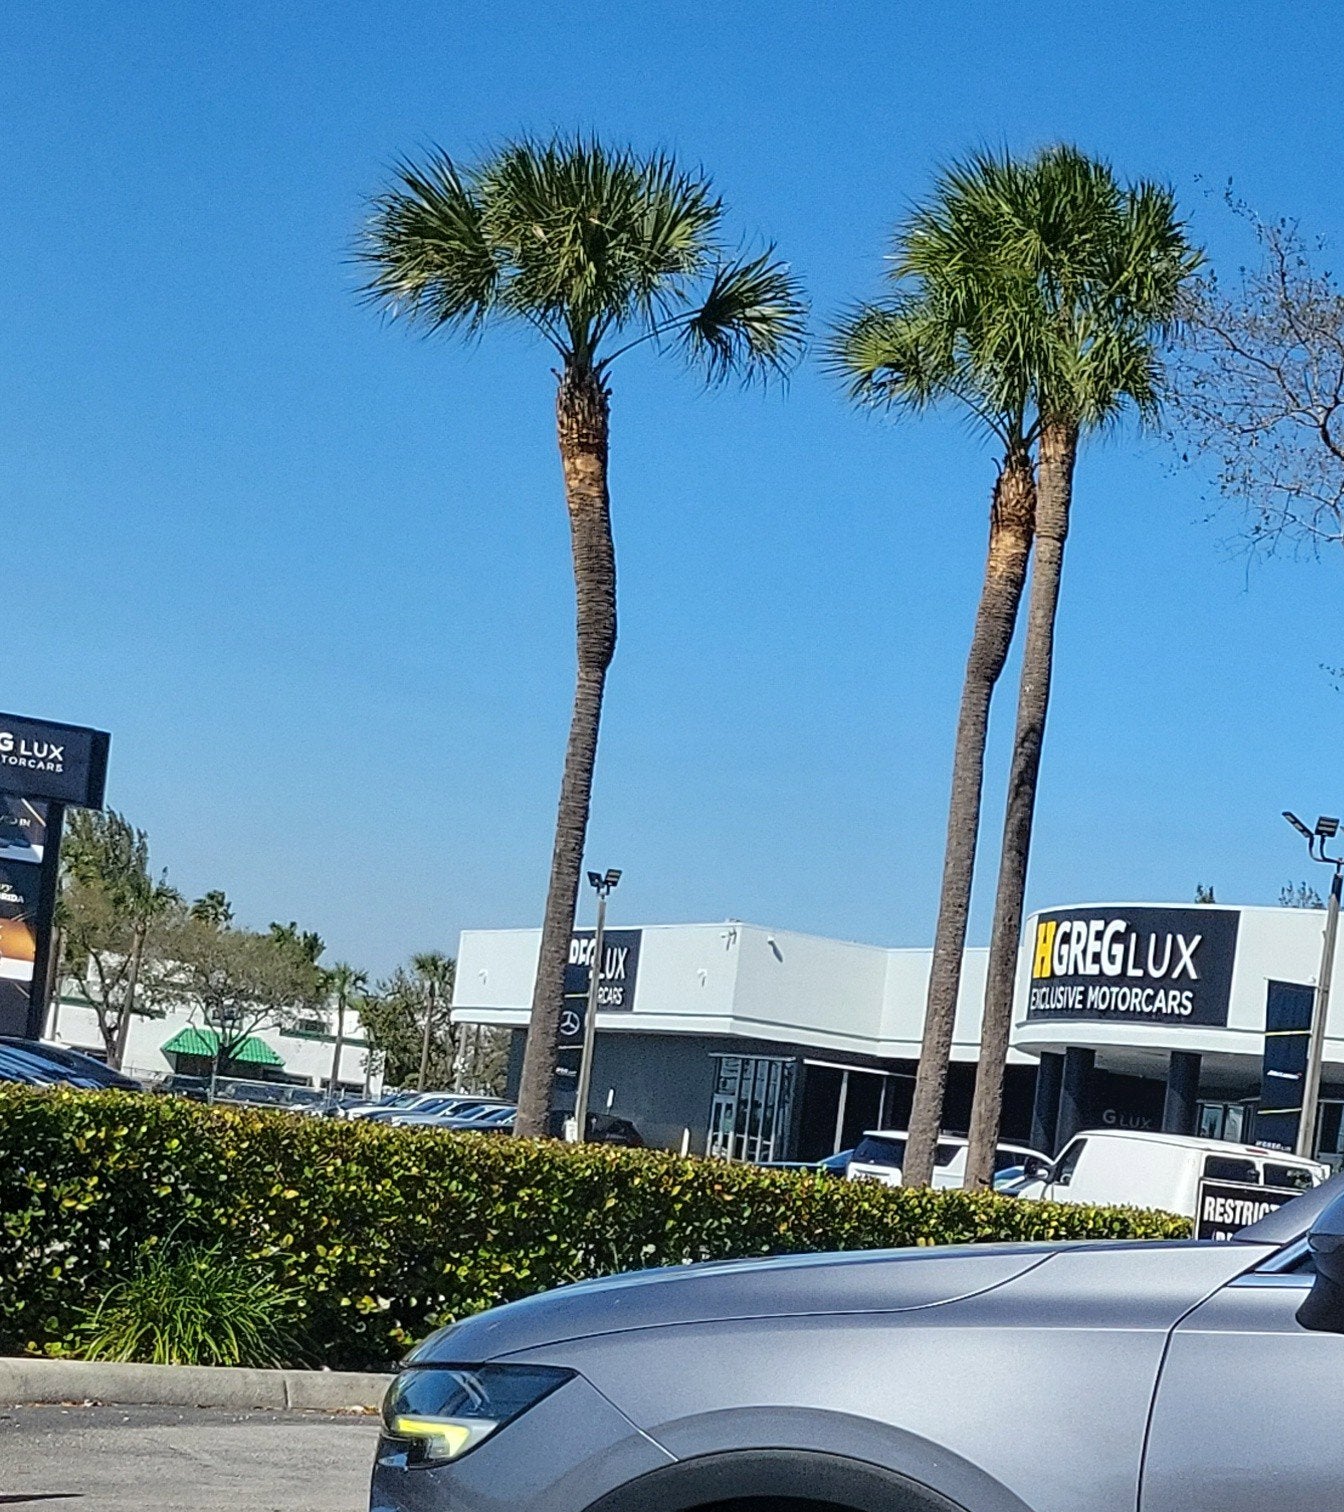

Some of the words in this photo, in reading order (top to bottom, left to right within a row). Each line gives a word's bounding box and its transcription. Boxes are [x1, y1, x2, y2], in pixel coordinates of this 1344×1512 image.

[20, 740, 64, 761] LUX
[1030, 985, 1085, 1011] EXCLUSIVE
[1087, 985, 1194, 1016] MOTORCARS
